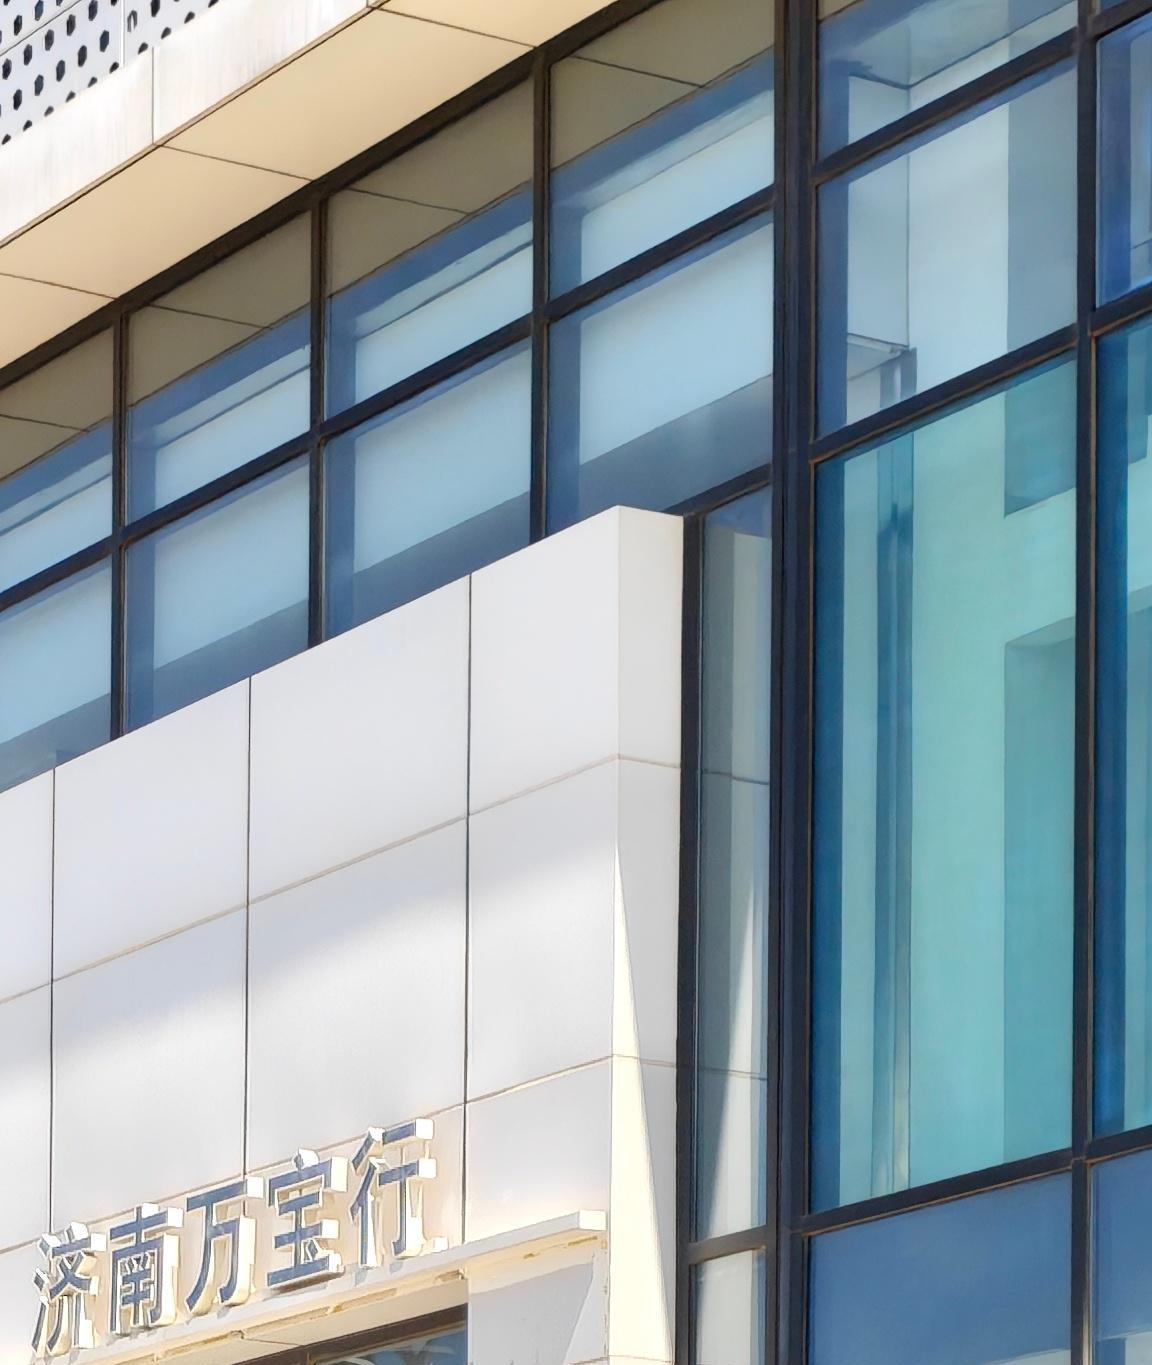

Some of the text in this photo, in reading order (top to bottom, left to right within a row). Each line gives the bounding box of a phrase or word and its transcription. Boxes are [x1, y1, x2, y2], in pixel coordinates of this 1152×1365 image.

[32, 1118, 440, 1358] 济南万宝行
